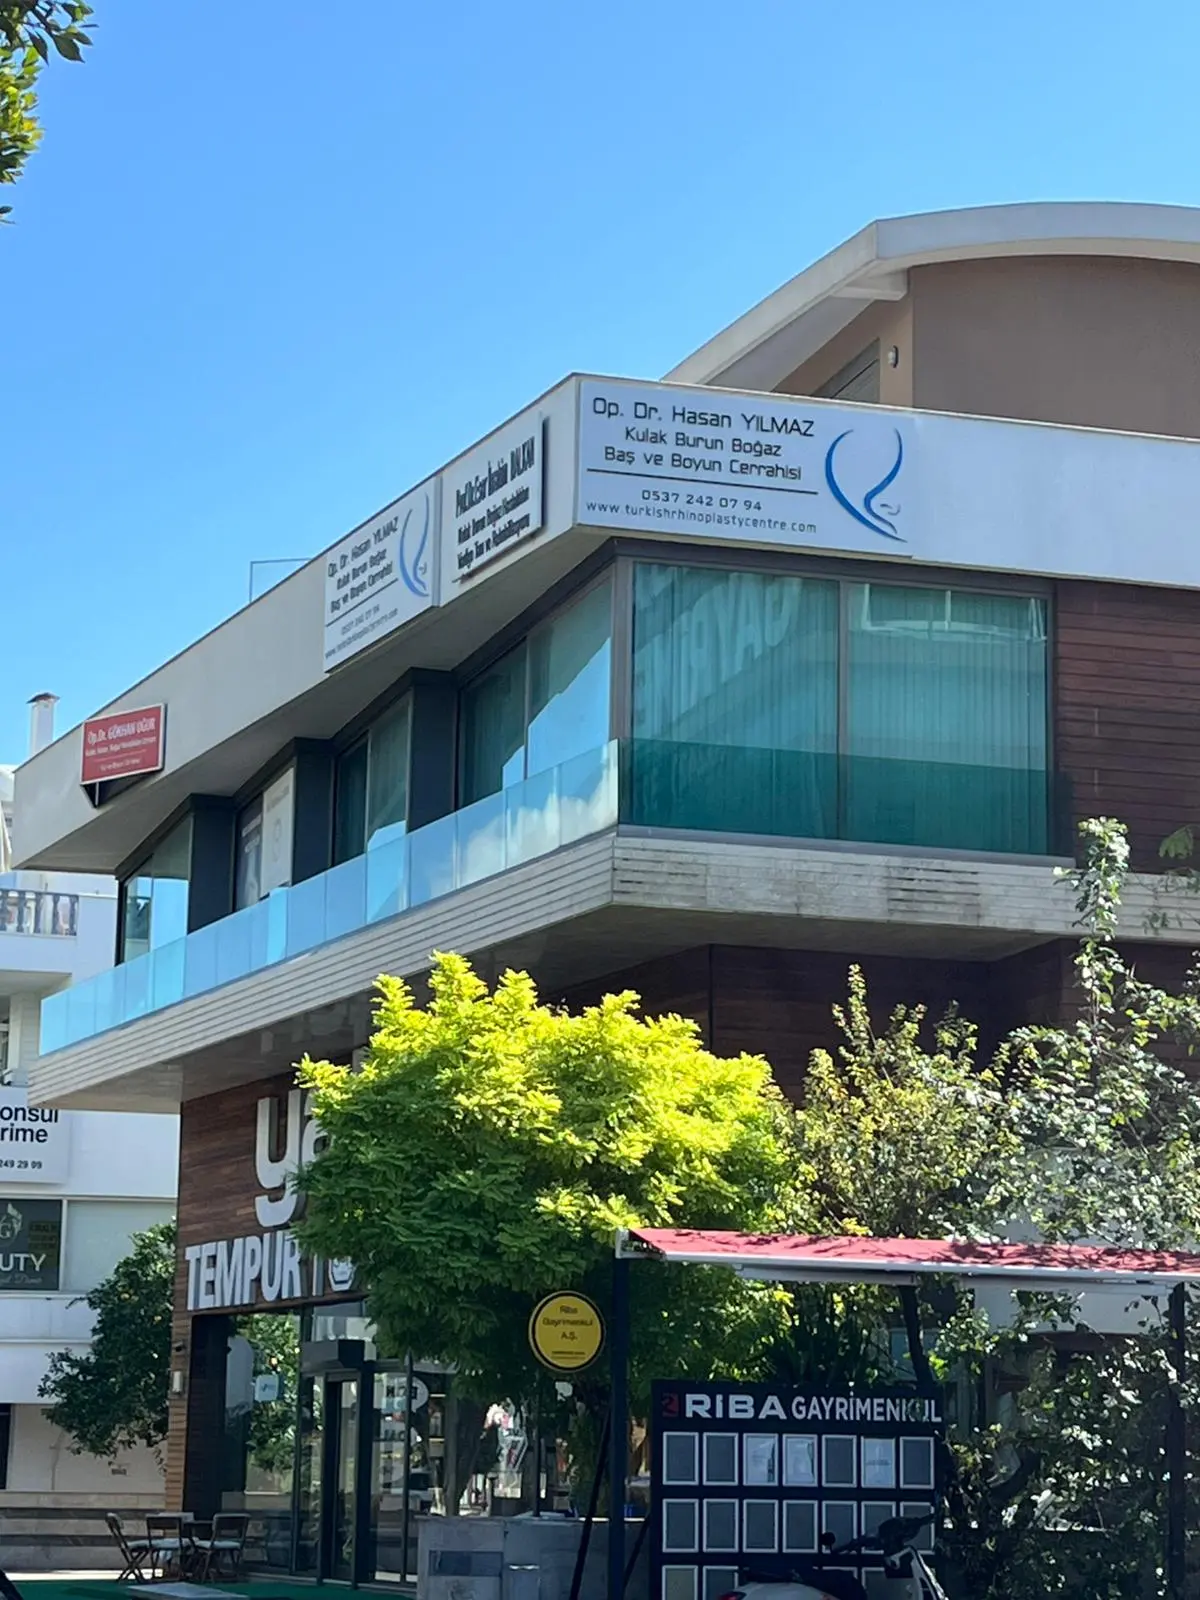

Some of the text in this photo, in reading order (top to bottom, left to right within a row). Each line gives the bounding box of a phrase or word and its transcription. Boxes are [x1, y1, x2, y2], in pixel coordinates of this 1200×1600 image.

[593, 397, 814, 437] Op. Dr. Hasan YILMAZ
[625, 426, 782, 457] Kulak Burun Boğaz
[605, 446, 801, 480] Baş ve Boyun Cerrahisi
[642, 489, 762, 511] 0537 242 07 94
[0, 1123, 48, 1143] rime
[685, 1394, 787, 1420] RIBA
